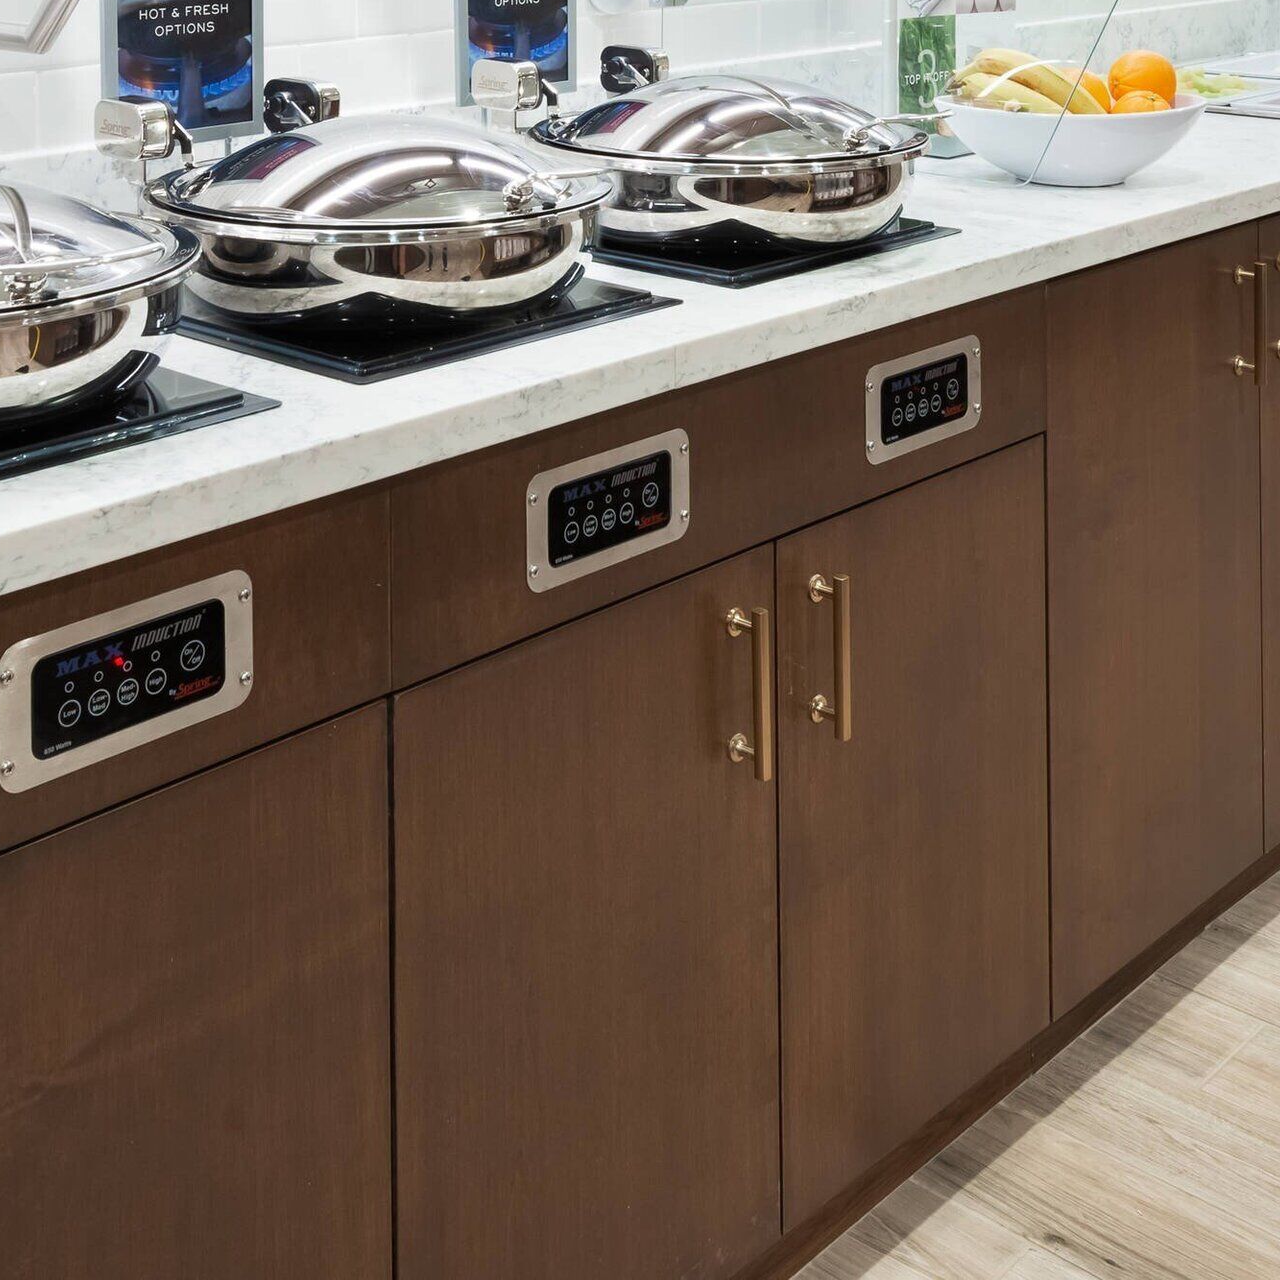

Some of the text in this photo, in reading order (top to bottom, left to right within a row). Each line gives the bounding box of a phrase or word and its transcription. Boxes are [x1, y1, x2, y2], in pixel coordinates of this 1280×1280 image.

[138, 3, 229, 20] HOT & FRESH
[154, 21, 215, 37] OPTIONS
[904, 73, 921, 86] TOP
[933, 70, 950, 83] OFF
[563, 478, 607, 503] MAX
[56, 613, 203, 678] MAX INDUCTION
